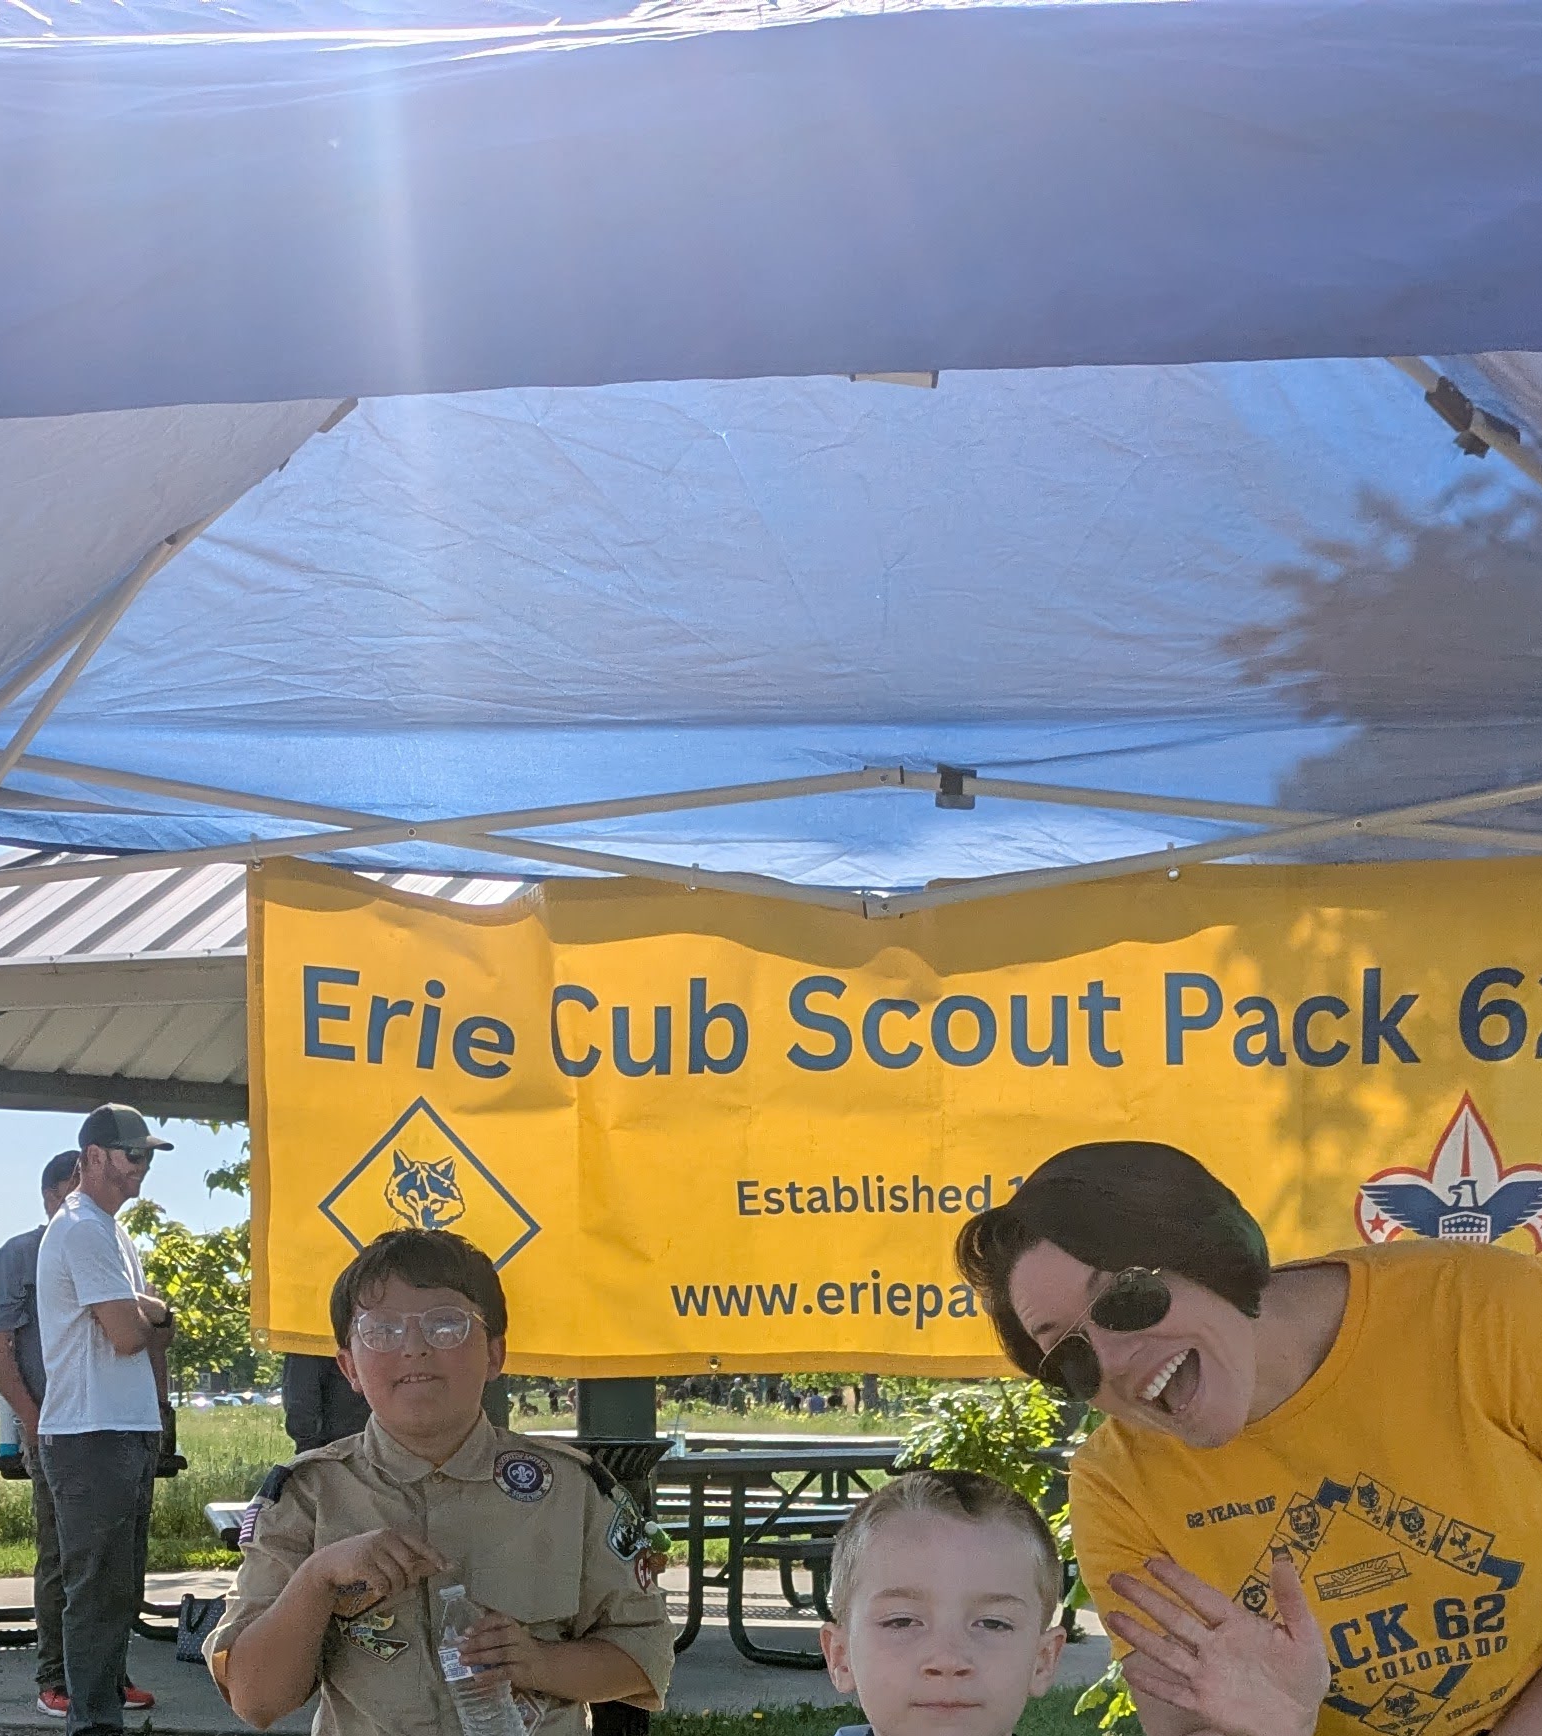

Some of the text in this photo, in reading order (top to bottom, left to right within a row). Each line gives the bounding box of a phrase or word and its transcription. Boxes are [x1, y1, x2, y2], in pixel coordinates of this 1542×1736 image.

[302, 964, 516, 1079] Erie
[550, 976, 750, 1078] Cub
[786, 974, 1124, 1072] Scout
[1163, 966, 1421, 1068] Pack
[735, 1174, 993, 1217] Established
[671, 1269, 988, 1330] www.eriepa
[1432, 1591, 1507, 1642] 62
[1363, 1635, 1509, 1684] COLORADO
